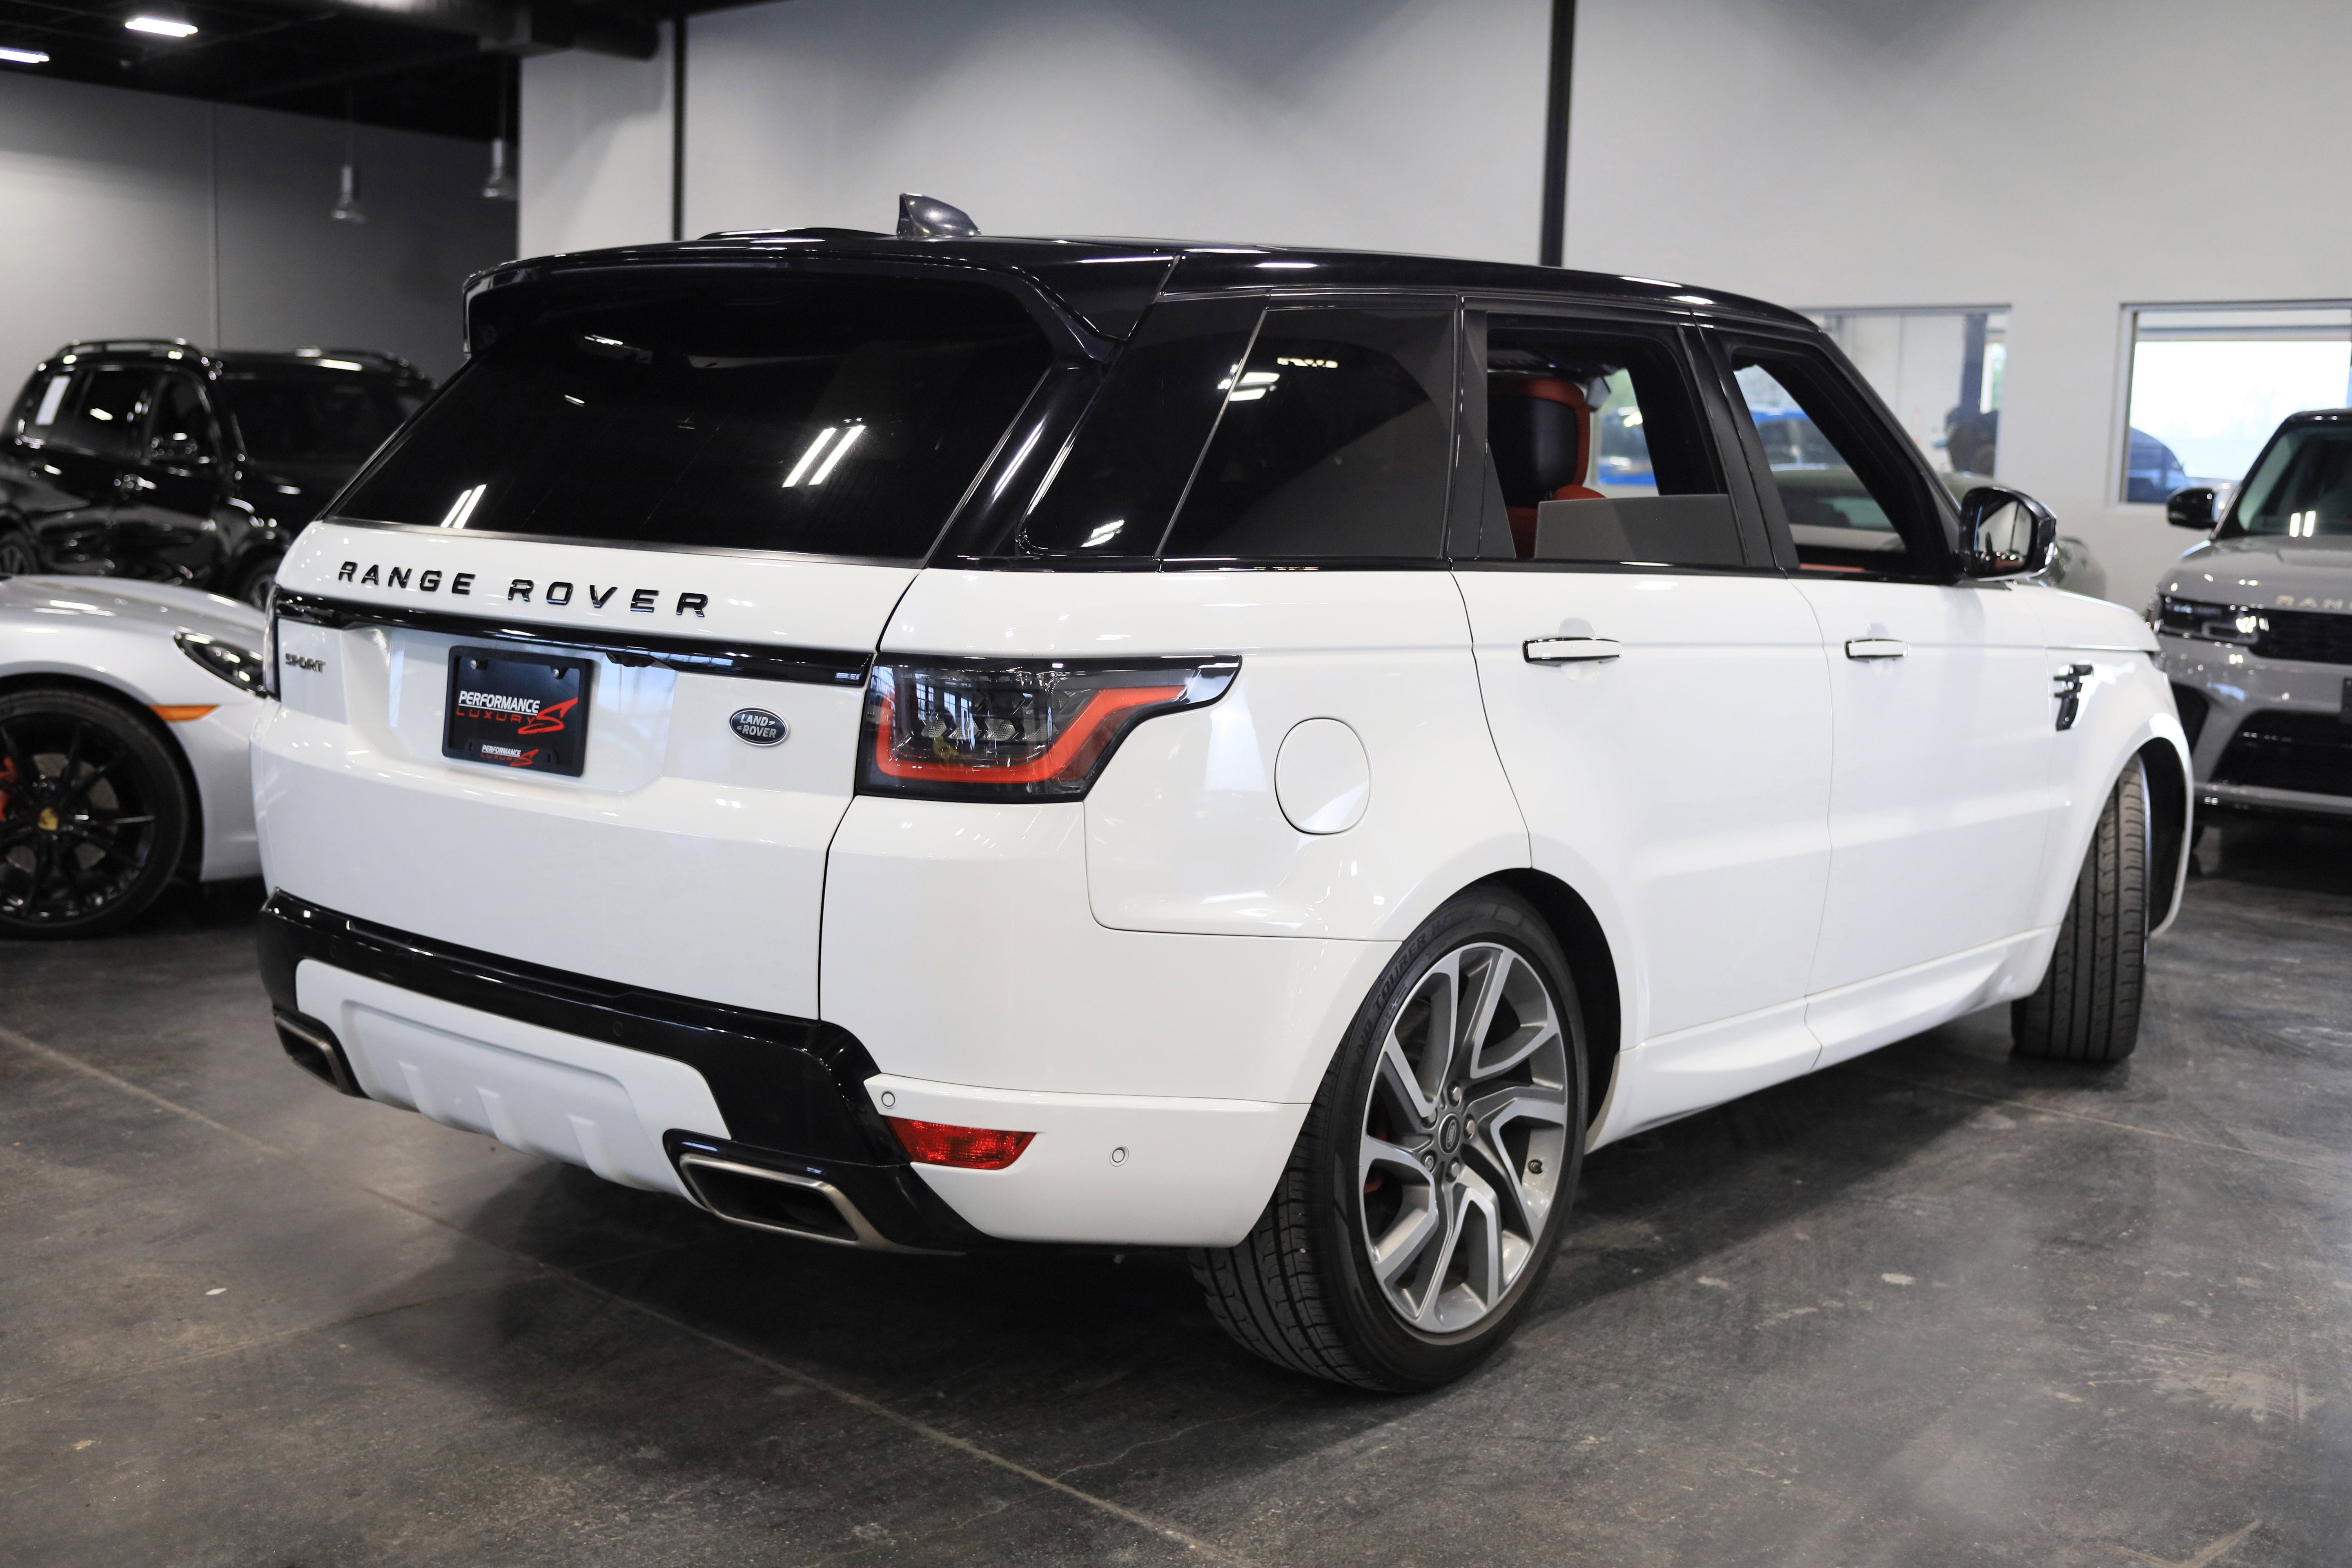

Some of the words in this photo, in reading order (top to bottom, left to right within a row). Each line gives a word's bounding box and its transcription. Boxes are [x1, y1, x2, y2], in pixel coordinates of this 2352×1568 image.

[338, 561, 476, 595] RANGE
[508, 578, 710, 617] ROVER
[2275, 595, 2352, 610] RAN
[285, 653, 326, 673] SPORT
[459, 690, 541, 713] PERFORMANCE
[740, 714, 768, 726] LAND
[742, 725, 777, 738] ROVER
[482, 744, 521, 756] PERFORMANCE
[1373, 933, 1428, 1011] TOURER
